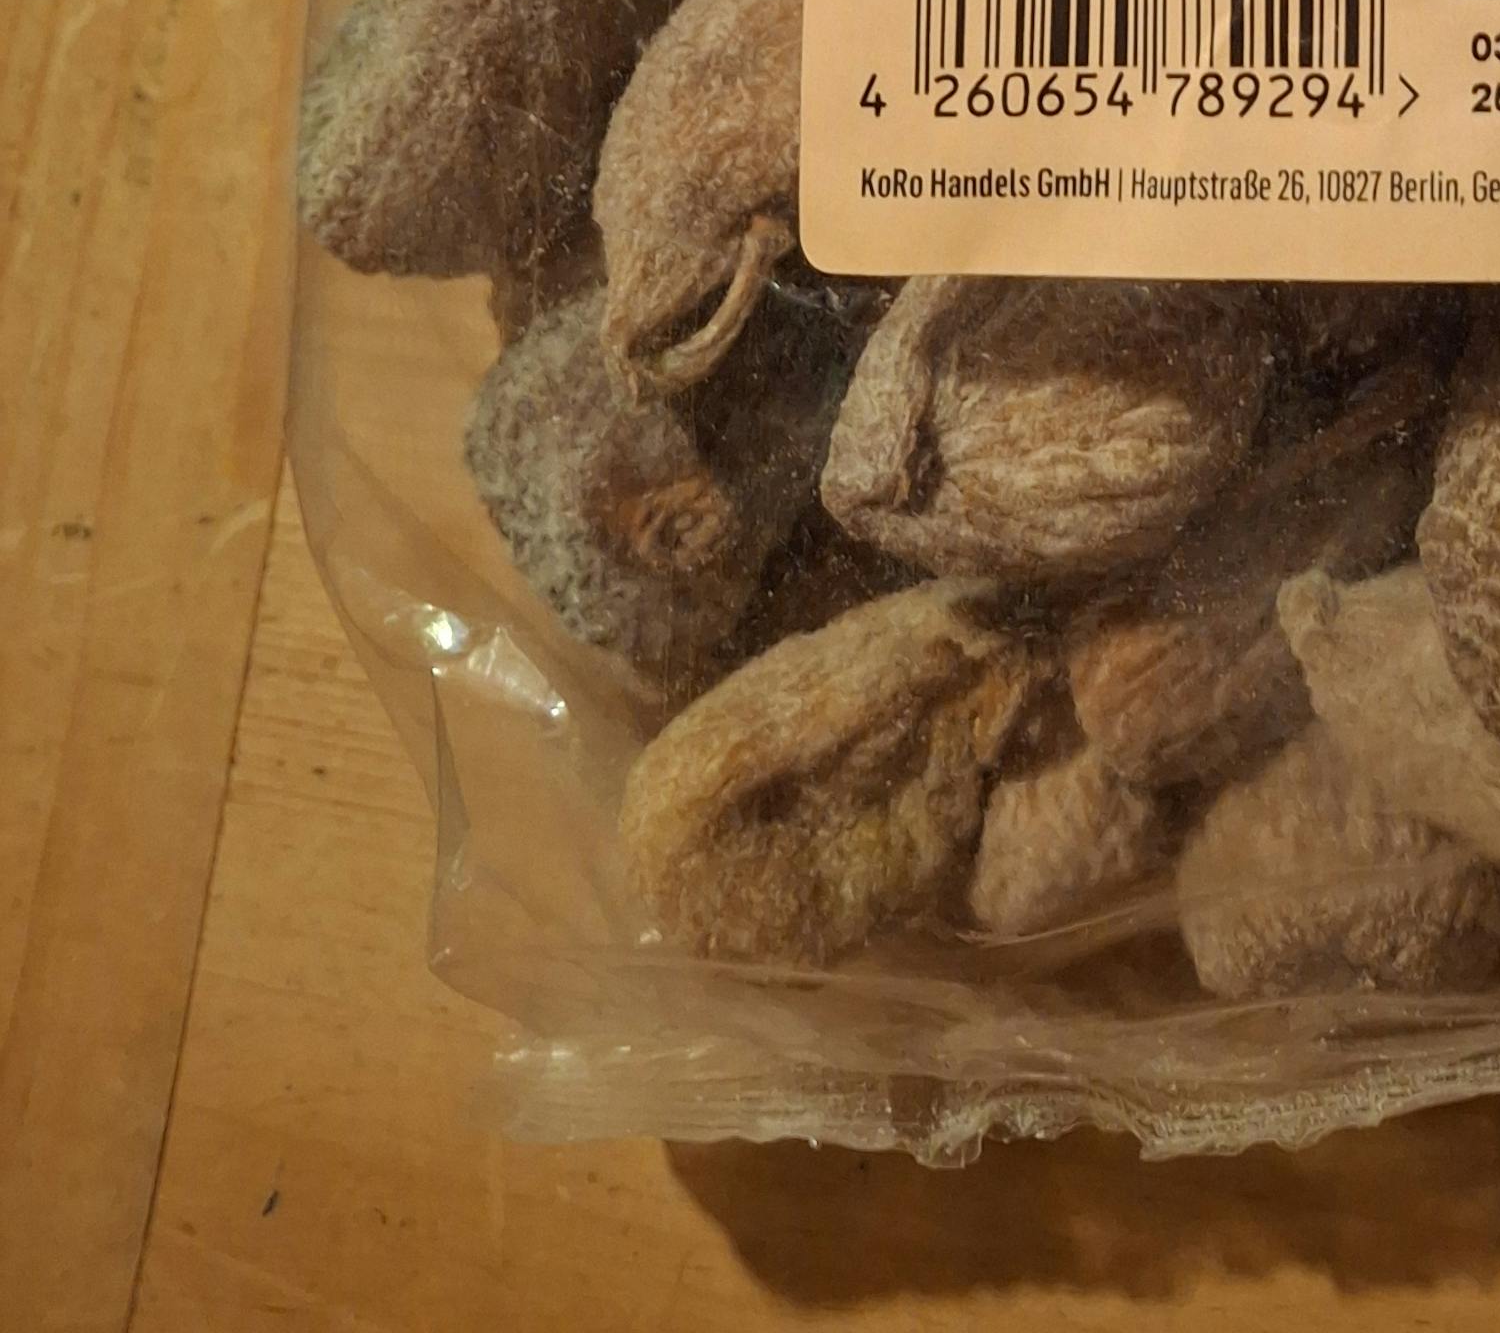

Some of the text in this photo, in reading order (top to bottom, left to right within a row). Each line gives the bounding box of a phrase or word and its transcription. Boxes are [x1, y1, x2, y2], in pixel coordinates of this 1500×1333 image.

[859, 72, 1365, 119] 4 260654 789294
[861, 167, 924, 199] KoRo
[930, 167, 1031, 198] Handels
[1037, 167, 1110, 198] GmbH
[1131, 167, 1272, 207] Hauptstraße
[1277, 169, 1311, 205] 26,
[1317, 169, 1383, 203] 10827
[1389, 170, 1465, 206] Berlin,
